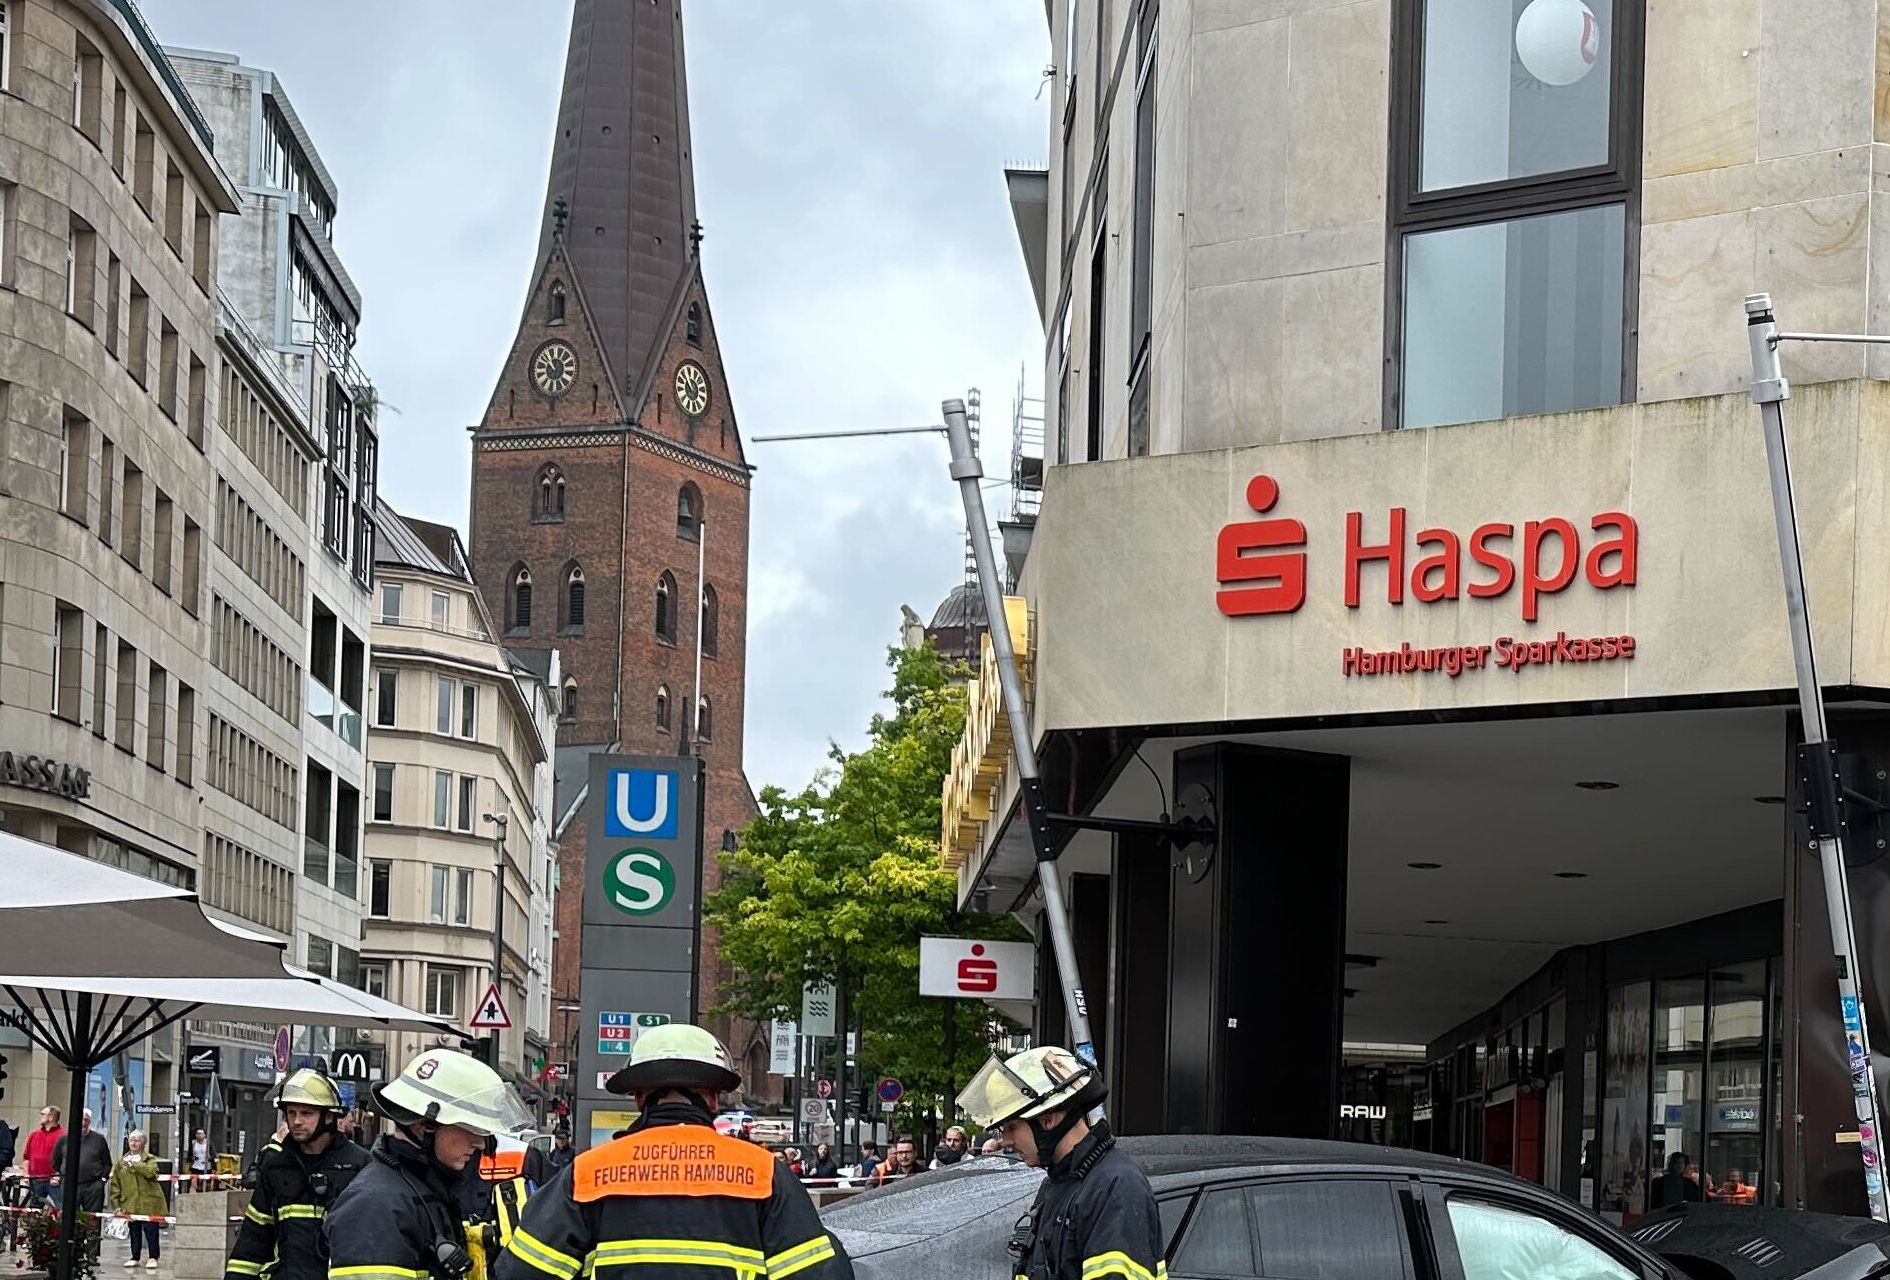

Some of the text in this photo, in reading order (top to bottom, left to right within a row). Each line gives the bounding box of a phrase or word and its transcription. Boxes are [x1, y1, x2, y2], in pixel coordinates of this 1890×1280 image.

[1343, 507, 1639, 621] Haspa
[1342, 632, 1636, 678] Hamburger Sparkasse
[616, 773, 668, 832] U
[615, 853, 664, 910] S
[606, 1028, 625, 1038] U2
[1340, 1104, 1386, 1119] RAW
[633, 1142, 716, 1161] ZUGFÜHRER
[594, 1164, 754, 1187] FEUERWEHR HAMBURG
